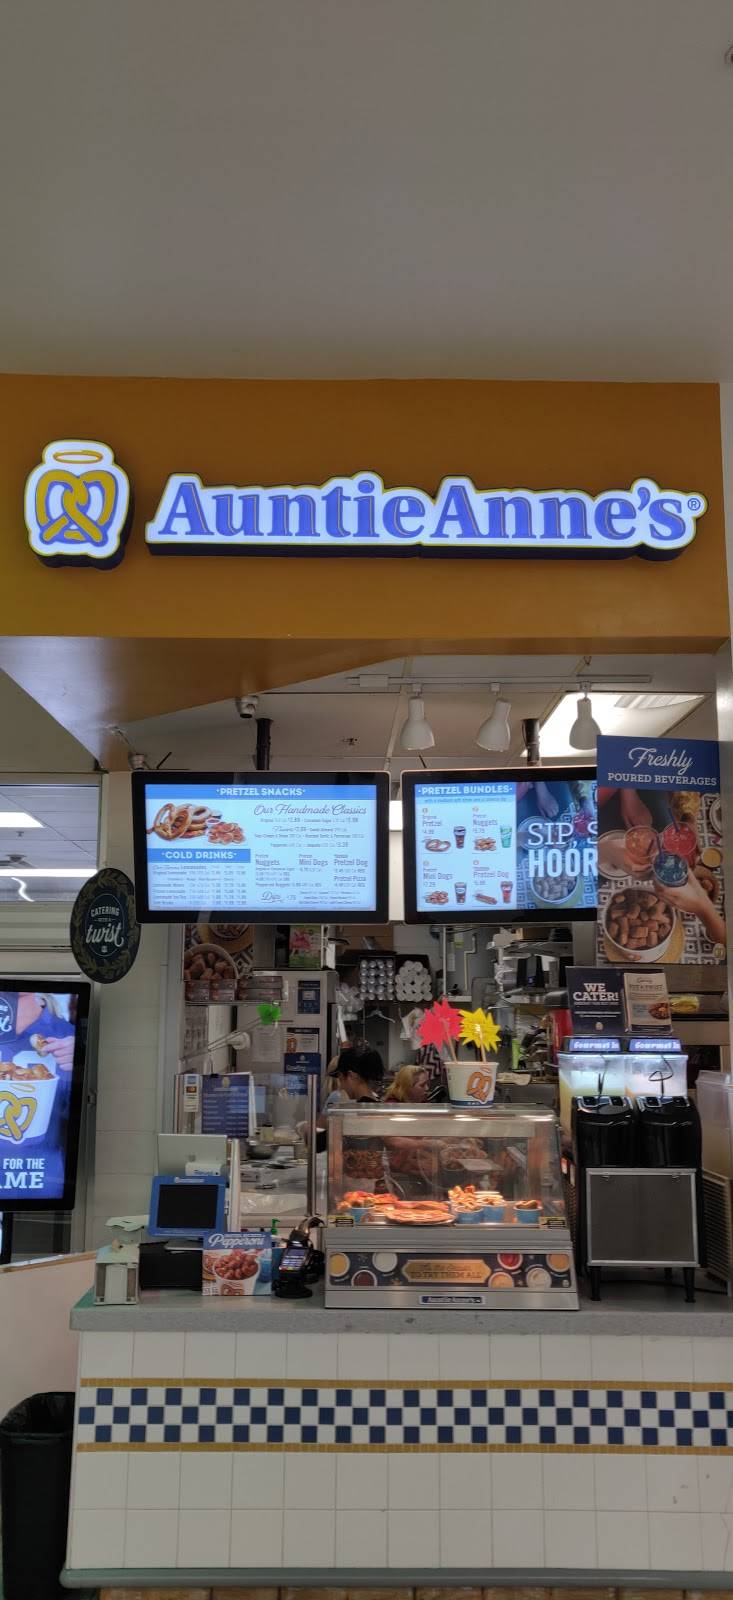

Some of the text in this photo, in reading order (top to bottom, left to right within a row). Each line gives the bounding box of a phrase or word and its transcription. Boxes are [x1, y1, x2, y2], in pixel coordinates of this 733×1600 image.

[158, 480, 687, 541] Auntie Anne's
[628, 747, 693, 775] Freshly
[608, 773, 717, 786] POURED BEVERAGES
[220, 787, 303, 796] PRETZEL SNACKS
[422, 785, 510, 795] PRETZEL BUNDLES
[253, 804, 367, 816] Our Handmade Classics
[528, 822, 577, 849] SIP,
[165, 851, 234, 859] COLD DRINKS
[528, 848, 598, 877] HOOR
[91, 906, 120, 917] CATERING
[86, 922, 124, 947] twist
[583, 983, 606, 992] WE
[573, 992, 619, 1001] CATER!
[3, 1158, 46, 1170] FOR THE
[0, 1171, 45, 1189] ME
[208, 1233, 265, 1249] Pepperoni
